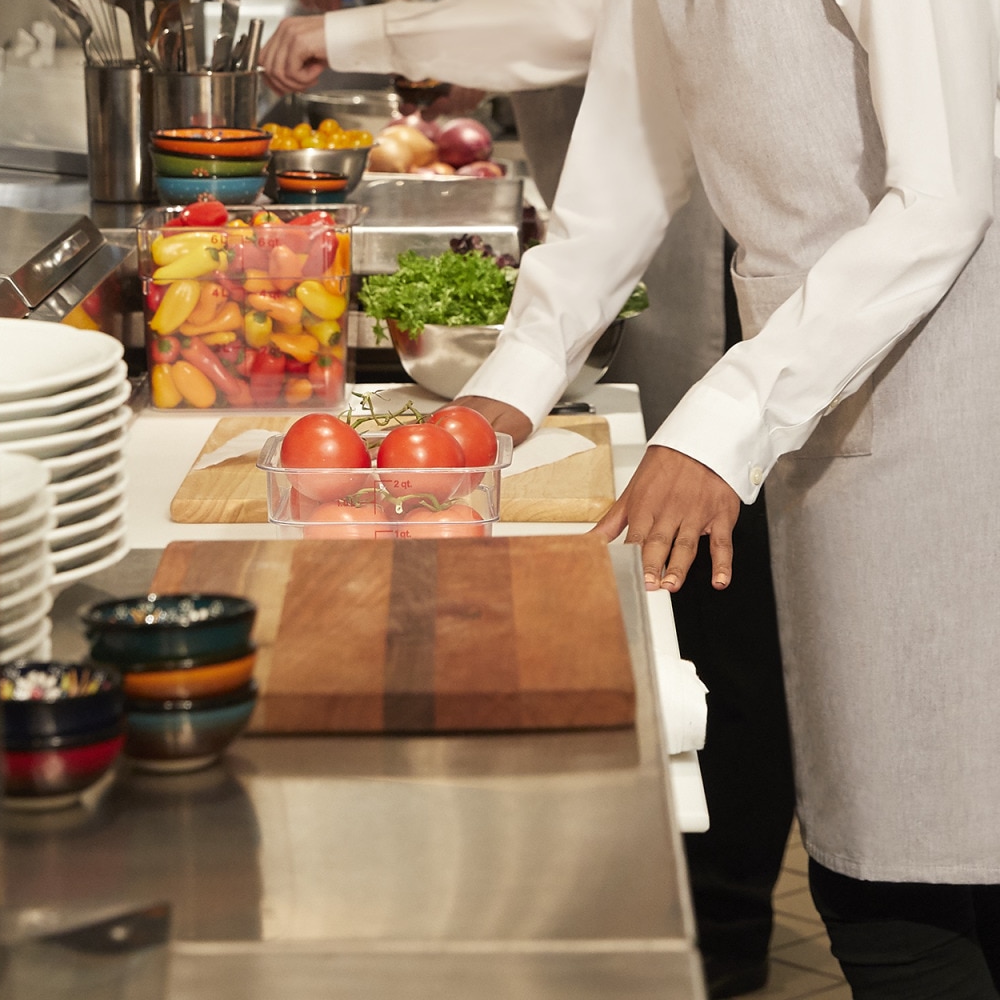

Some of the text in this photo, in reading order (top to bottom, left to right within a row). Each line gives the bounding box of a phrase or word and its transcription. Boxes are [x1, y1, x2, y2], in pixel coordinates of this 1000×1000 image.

[211, 235, 218, 244] 6
[212, 288, 219, 297] 4
[393, 480, 412, 489] 2 qt.
[394, 529, 412, 539] 1 qt.
